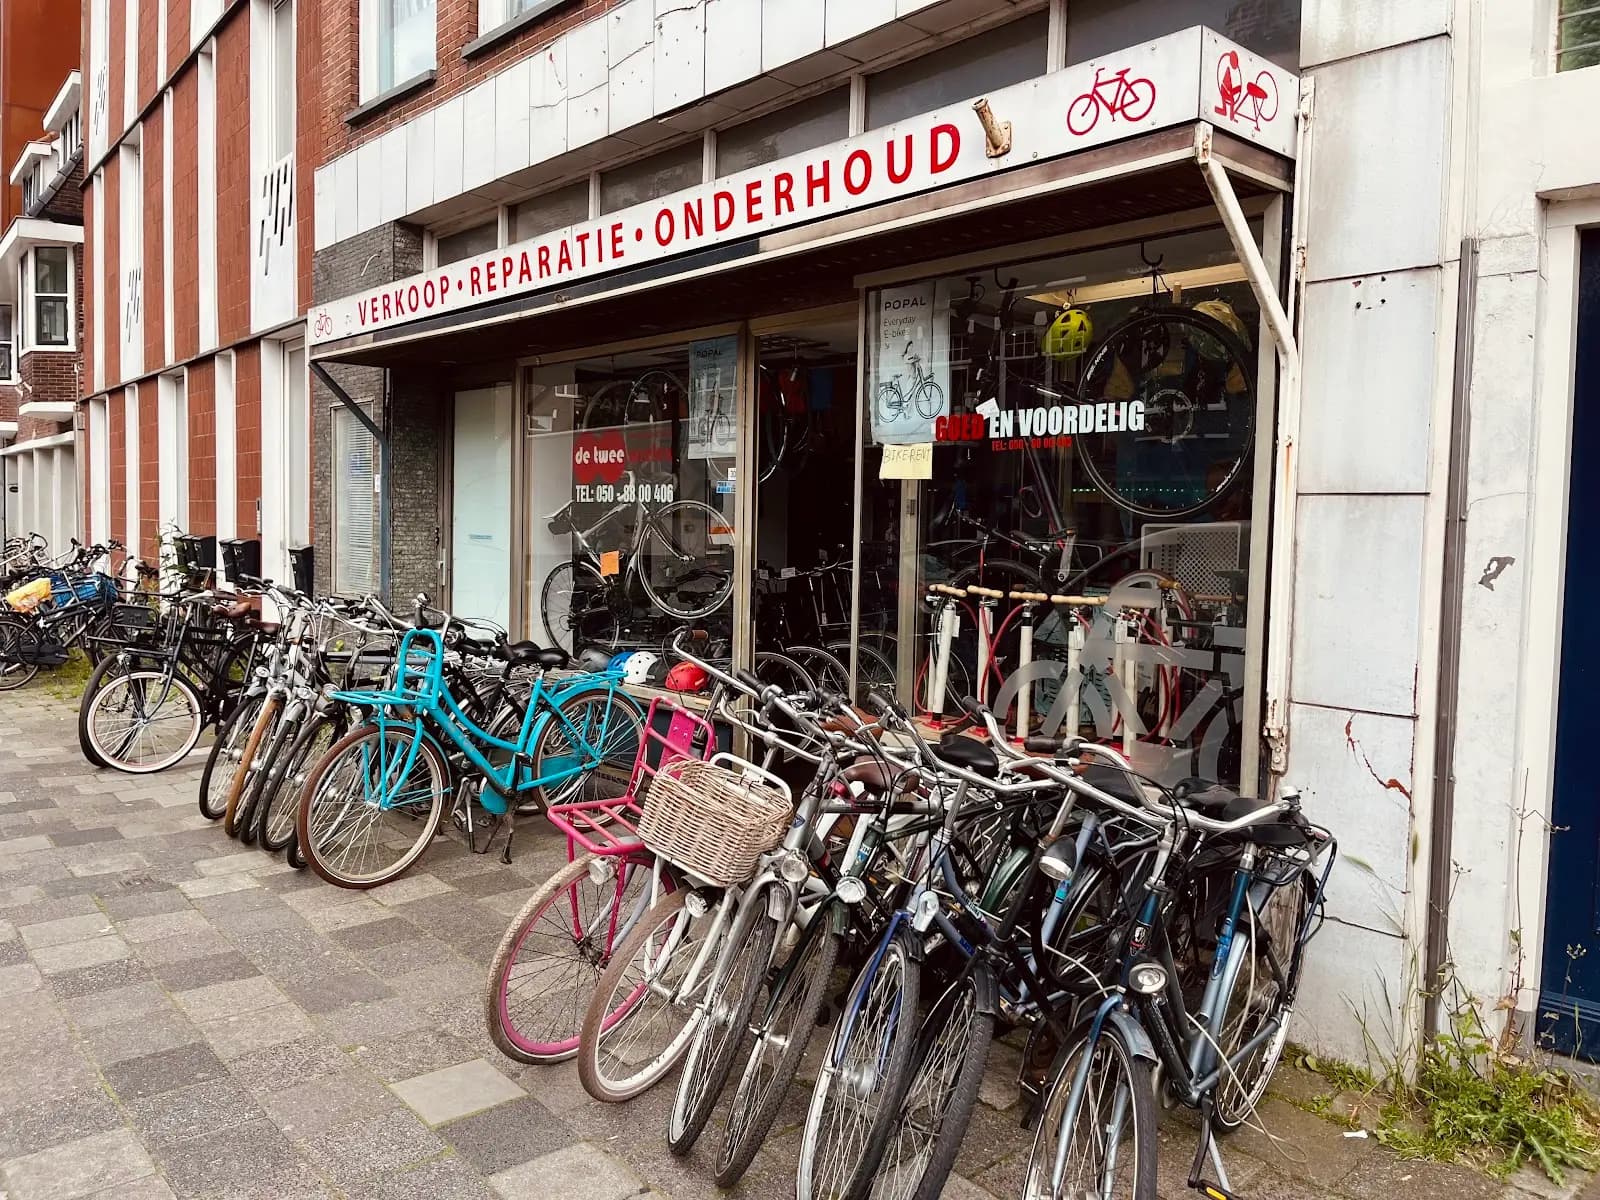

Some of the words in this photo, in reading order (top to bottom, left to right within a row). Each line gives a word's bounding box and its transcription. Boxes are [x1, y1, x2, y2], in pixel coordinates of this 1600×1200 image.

[358, 275, 449, 326] VERKOOP
[470, 222, 624, 296] REPARATIE
[655, 123, 961, 247] ONDERHOUD
[884, 296, 926, 311] POPAL
[935, 414, 984, 441] GOED
[989, 410, 1014, 438] EN
[1019, 400, 1145, 437] VOORDELIG
[575, 446, 590, 464] de
[593, 445, 625, 464] twee
[576, 485, 594, 502] TEL:
[596, 484, 614, 502] 050
[623, 484, 636, 502] 88
[638, 484, 651, 502] 00
[654, 483, 674, 502] 406
